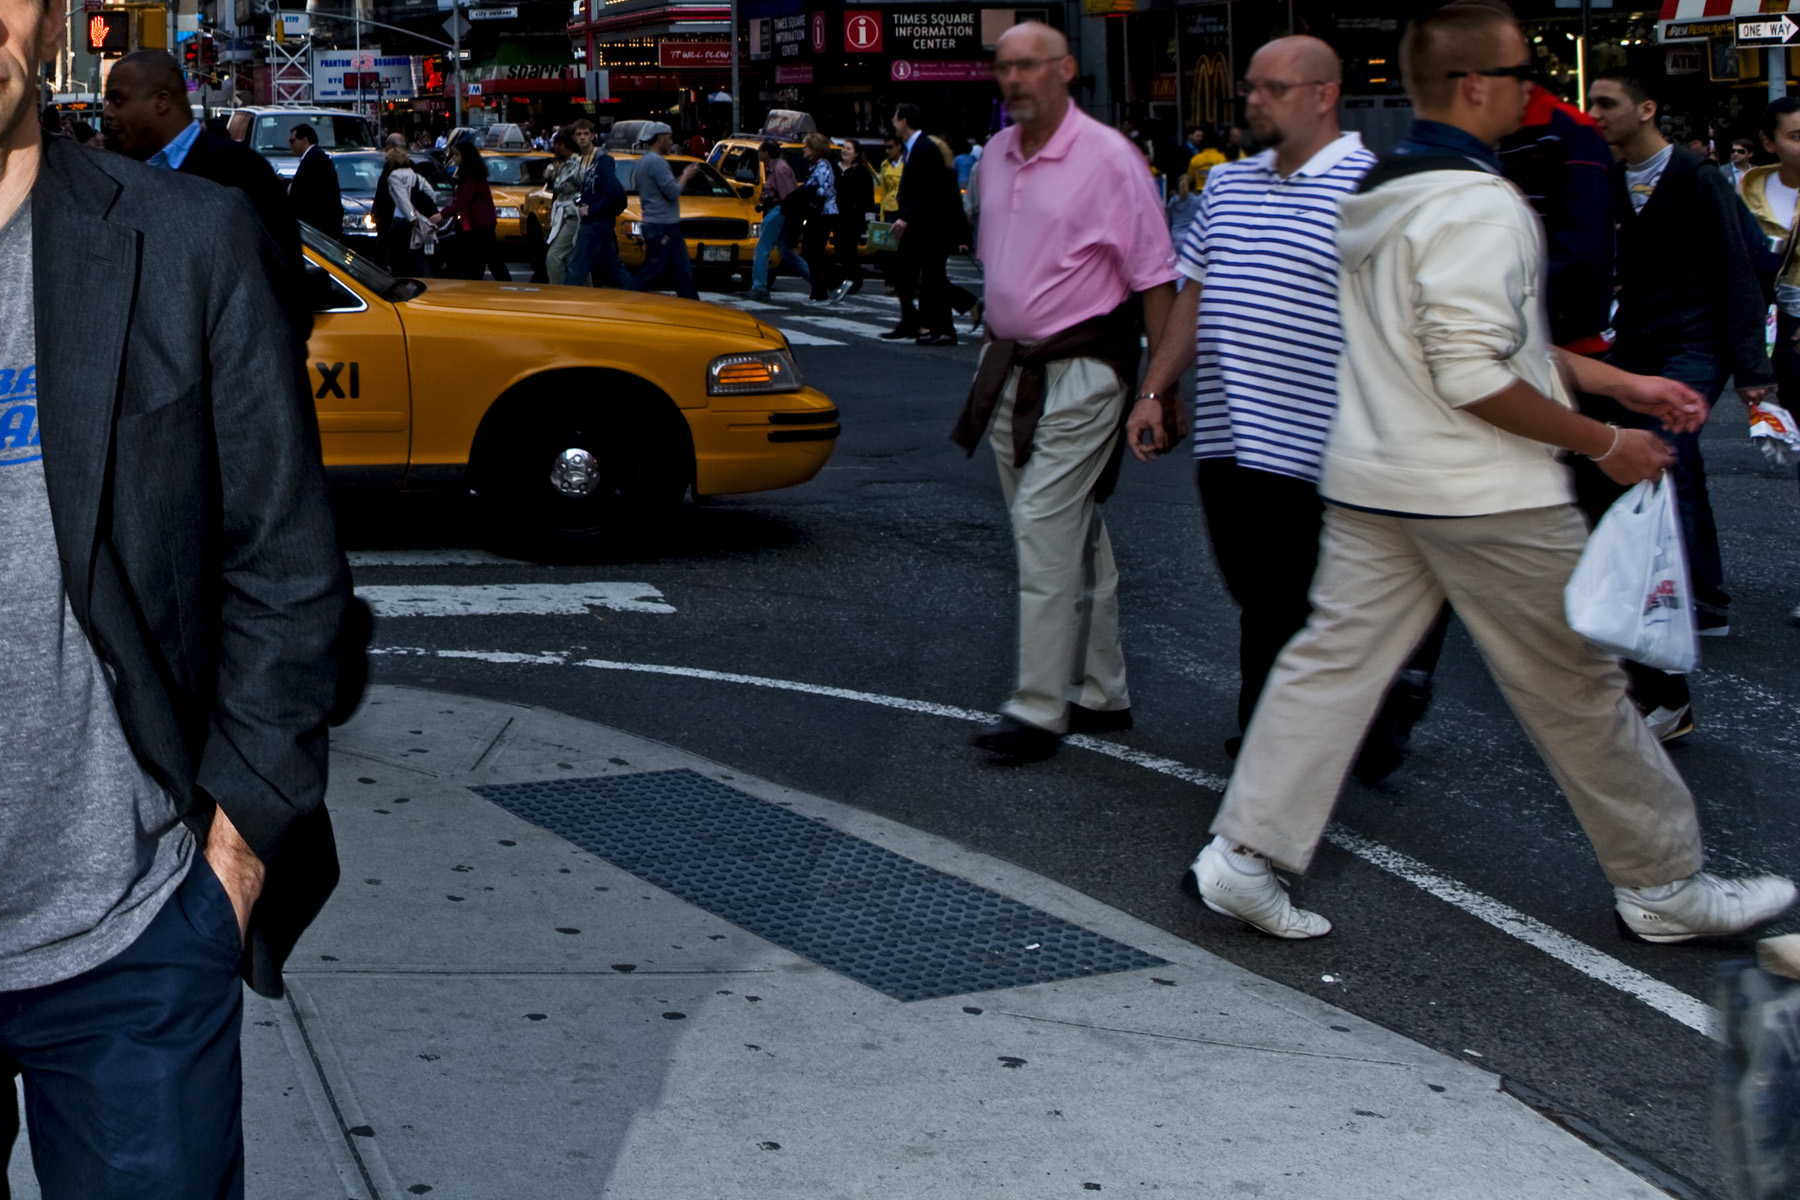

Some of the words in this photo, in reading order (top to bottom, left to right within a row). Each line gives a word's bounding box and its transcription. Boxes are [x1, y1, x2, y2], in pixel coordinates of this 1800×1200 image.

[774, 15, 787, 30] TIMES
[787, 13, 806, 28] SQUARE
[892, 13, 928, 25] TIMES
[930, 12, 976, 25] SQUARE
[774, 28, 806, 44] INFORMATION
[895, 25, 974, 38] INFORMATION
[1742, 24, 1762, 38] ONE
[1769, 23, 1793, 37] WAY
[912, 37, 957, 50] CENTER
[781, 45, 799, 57] CENTER
[319, 58, 352, 68] PHANTOM
[1670, 53, 1699, 70] ATM
